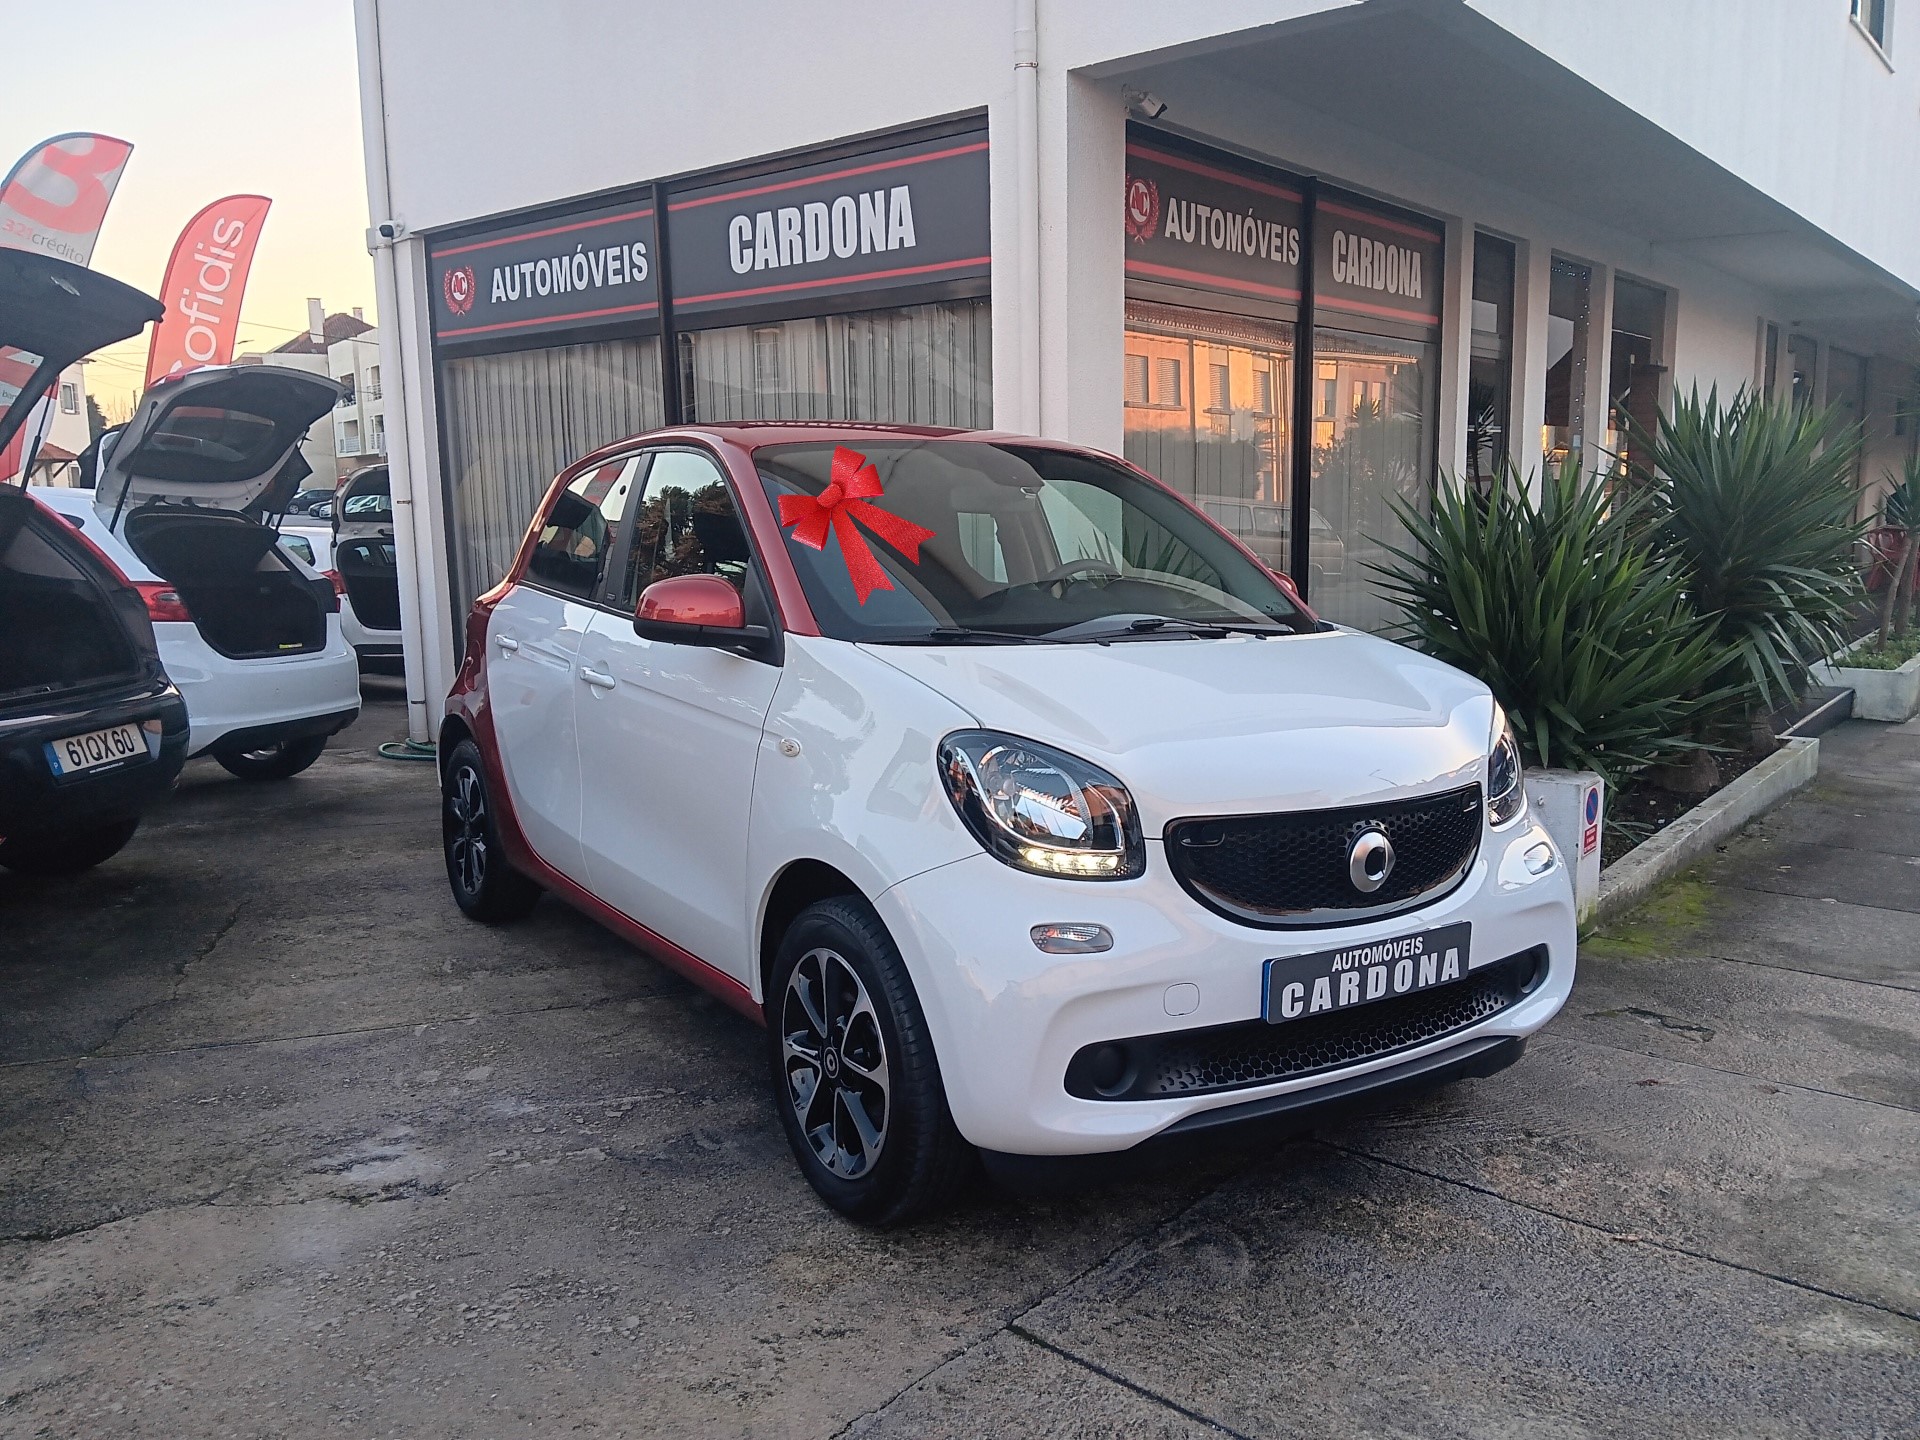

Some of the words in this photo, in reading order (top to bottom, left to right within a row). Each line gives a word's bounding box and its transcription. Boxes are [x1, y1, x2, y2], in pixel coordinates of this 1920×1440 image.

[490, 241, 649, 303] AUTOMÓVEIS
[728, 185, 916, 275] CARDONA
[1165, 197, 1300, 266] AUTOMÓVEIS
[1332, 230, 1422, 299] CARDONA
[65, 728, 135, 767] 61QX60
[1281, 948, 1460, 1019] CARDONA
[1331, 936, 1424, 972] AUTOMÓVEIS
